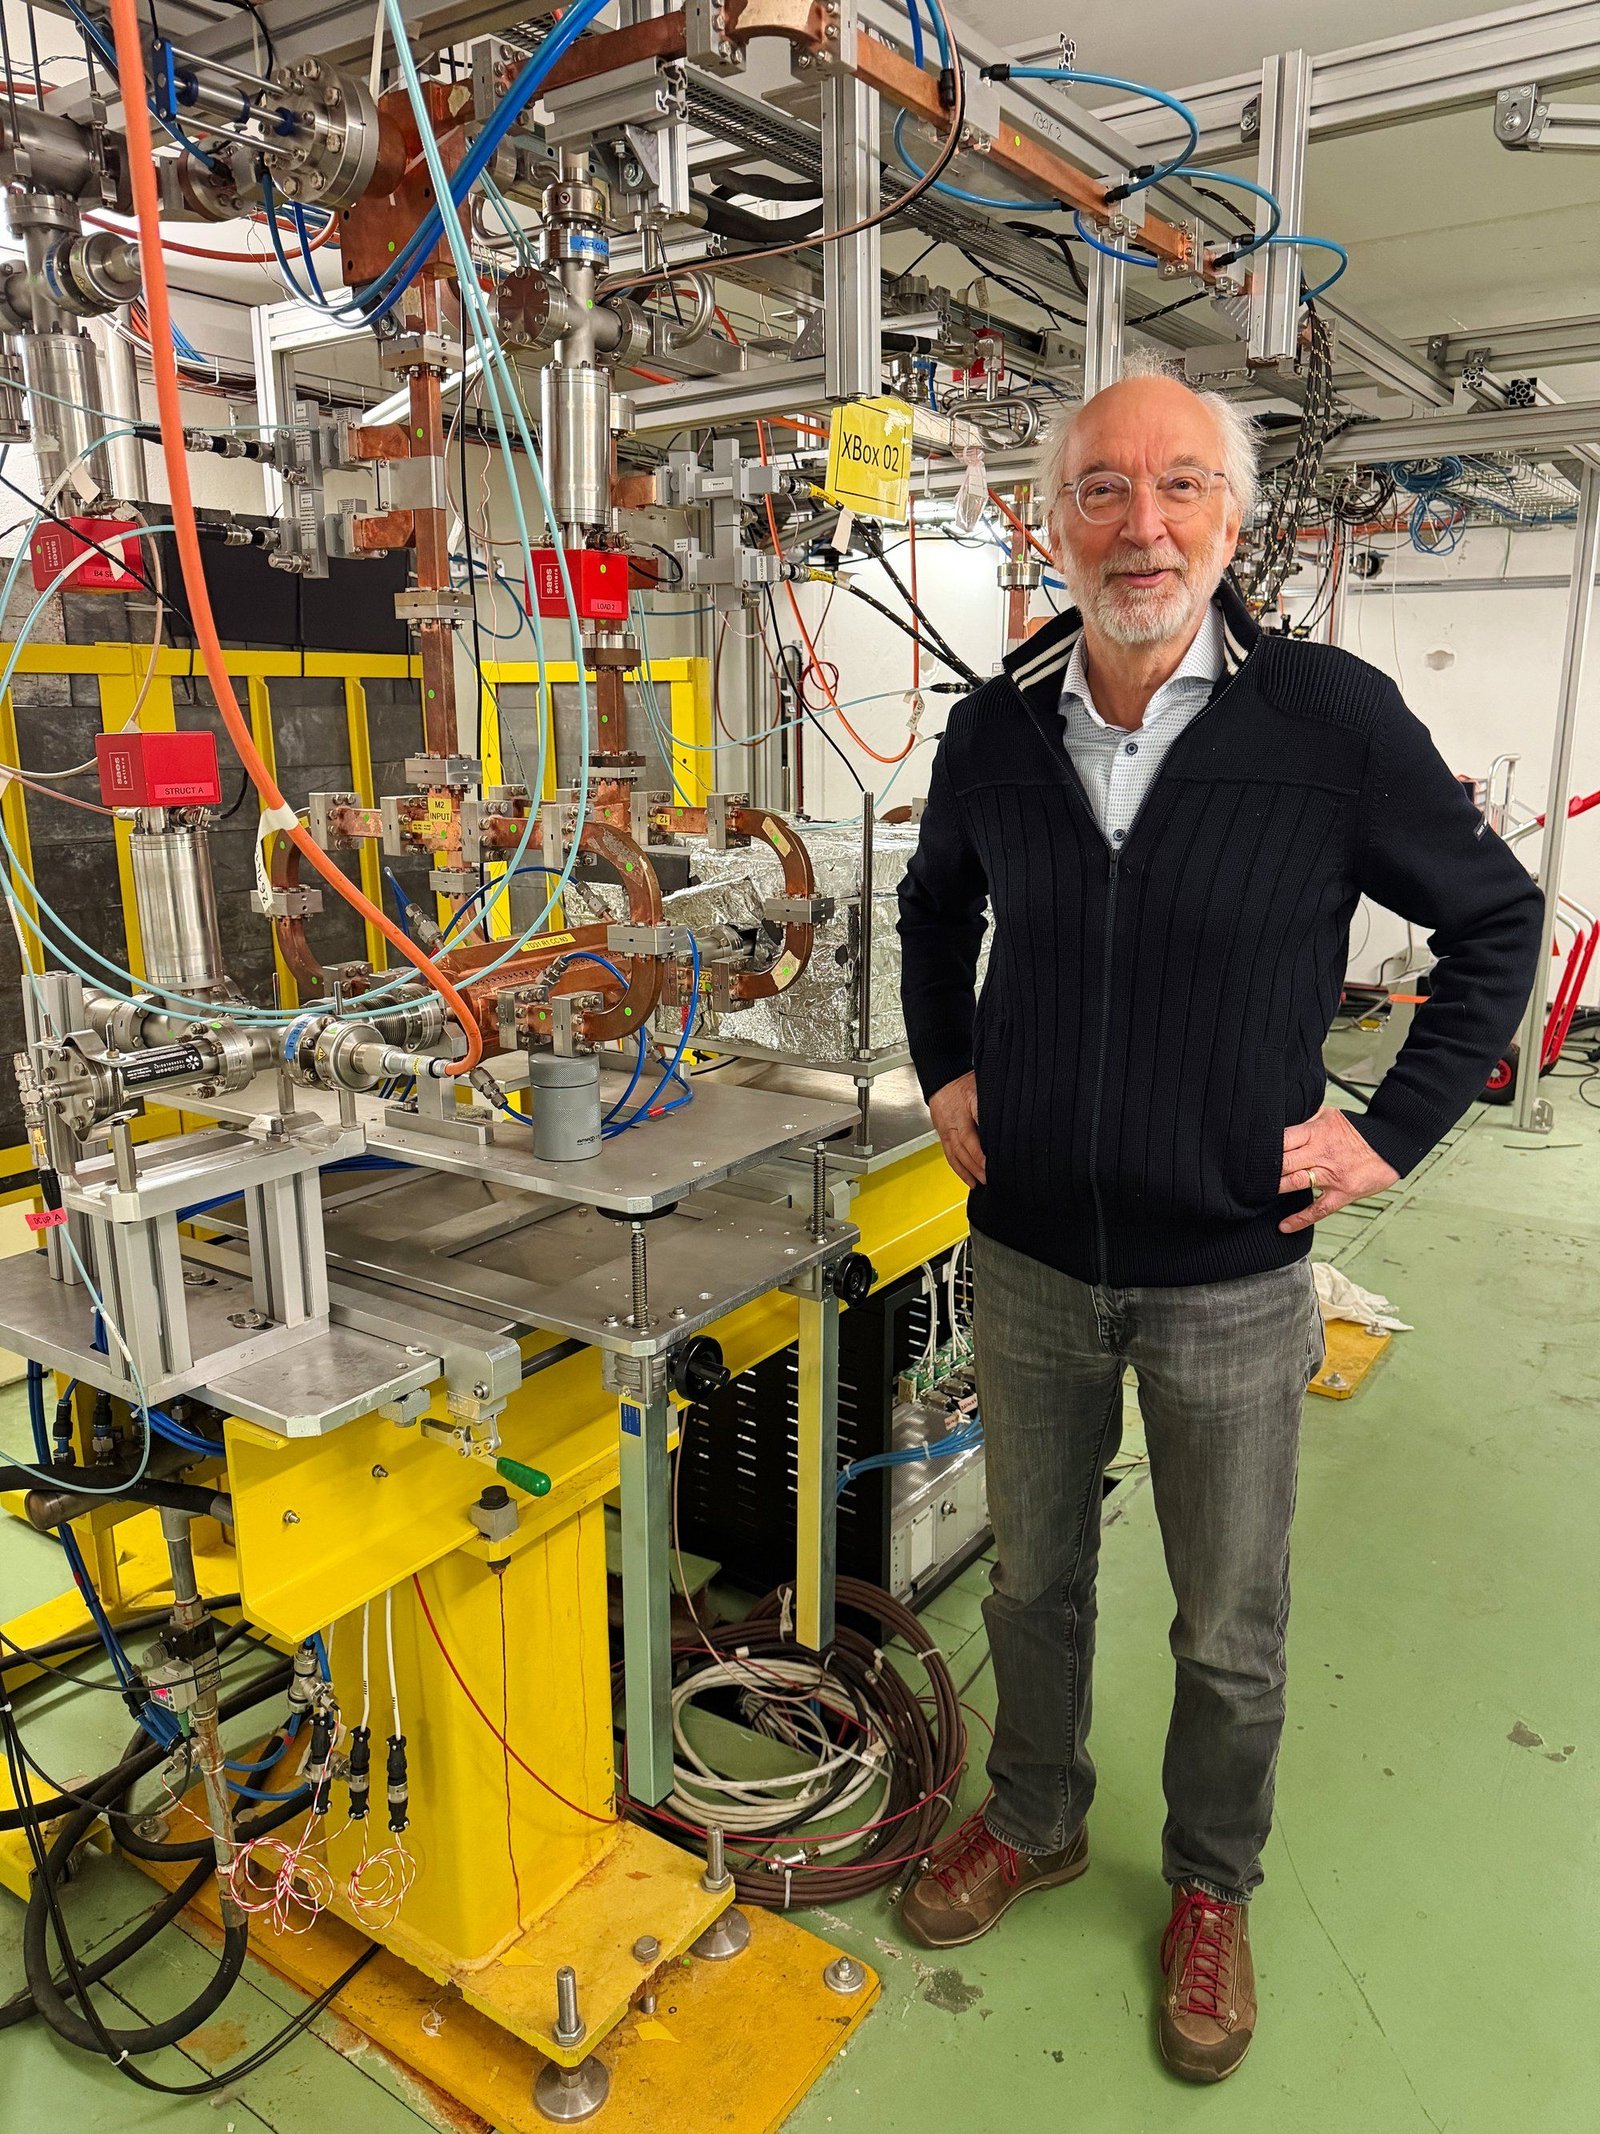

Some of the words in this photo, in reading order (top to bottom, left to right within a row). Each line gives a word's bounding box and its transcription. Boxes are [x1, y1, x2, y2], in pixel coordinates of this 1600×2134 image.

[841, 431, 880, 467] XBox
[883, 444, 899, 473] 02
[597, 603, 611, 611] LOAD
[165, 787, 196, 796] STRUCT
[198, 786, 204, 794] A
[435, 800, 445, 809] M2
[430, 812, 450, 821] INPUT
[660, 815, 668, 823] 12
[54, 1213, 62, 1222] A
